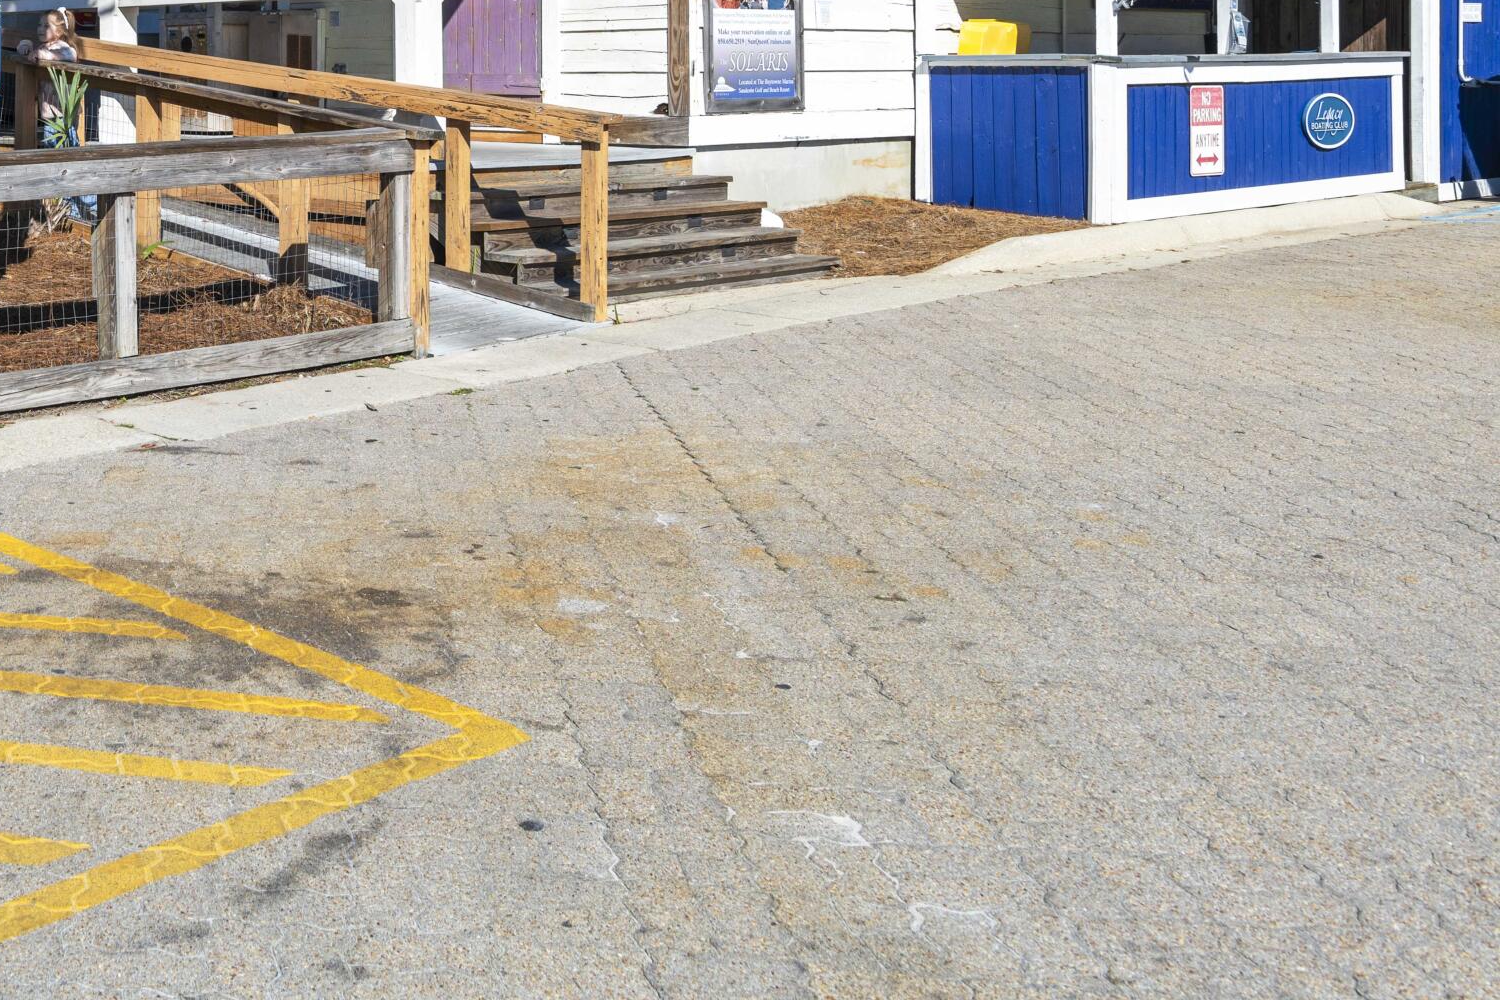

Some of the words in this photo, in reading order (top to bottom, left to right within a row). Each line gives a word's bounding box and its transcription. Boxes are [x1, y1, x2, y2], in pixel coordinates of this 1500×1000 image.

[728, 51, 789, 72] SOLARIS
[1201, 91, 1211, 104] NO
[1193, 107, 1221, 122] PARKING
[1311, 121, 1333, 130] BOATING
[1334, 120, 1349, 129] CLUB
[1196, 133, 1220, 147] ANYTIME
